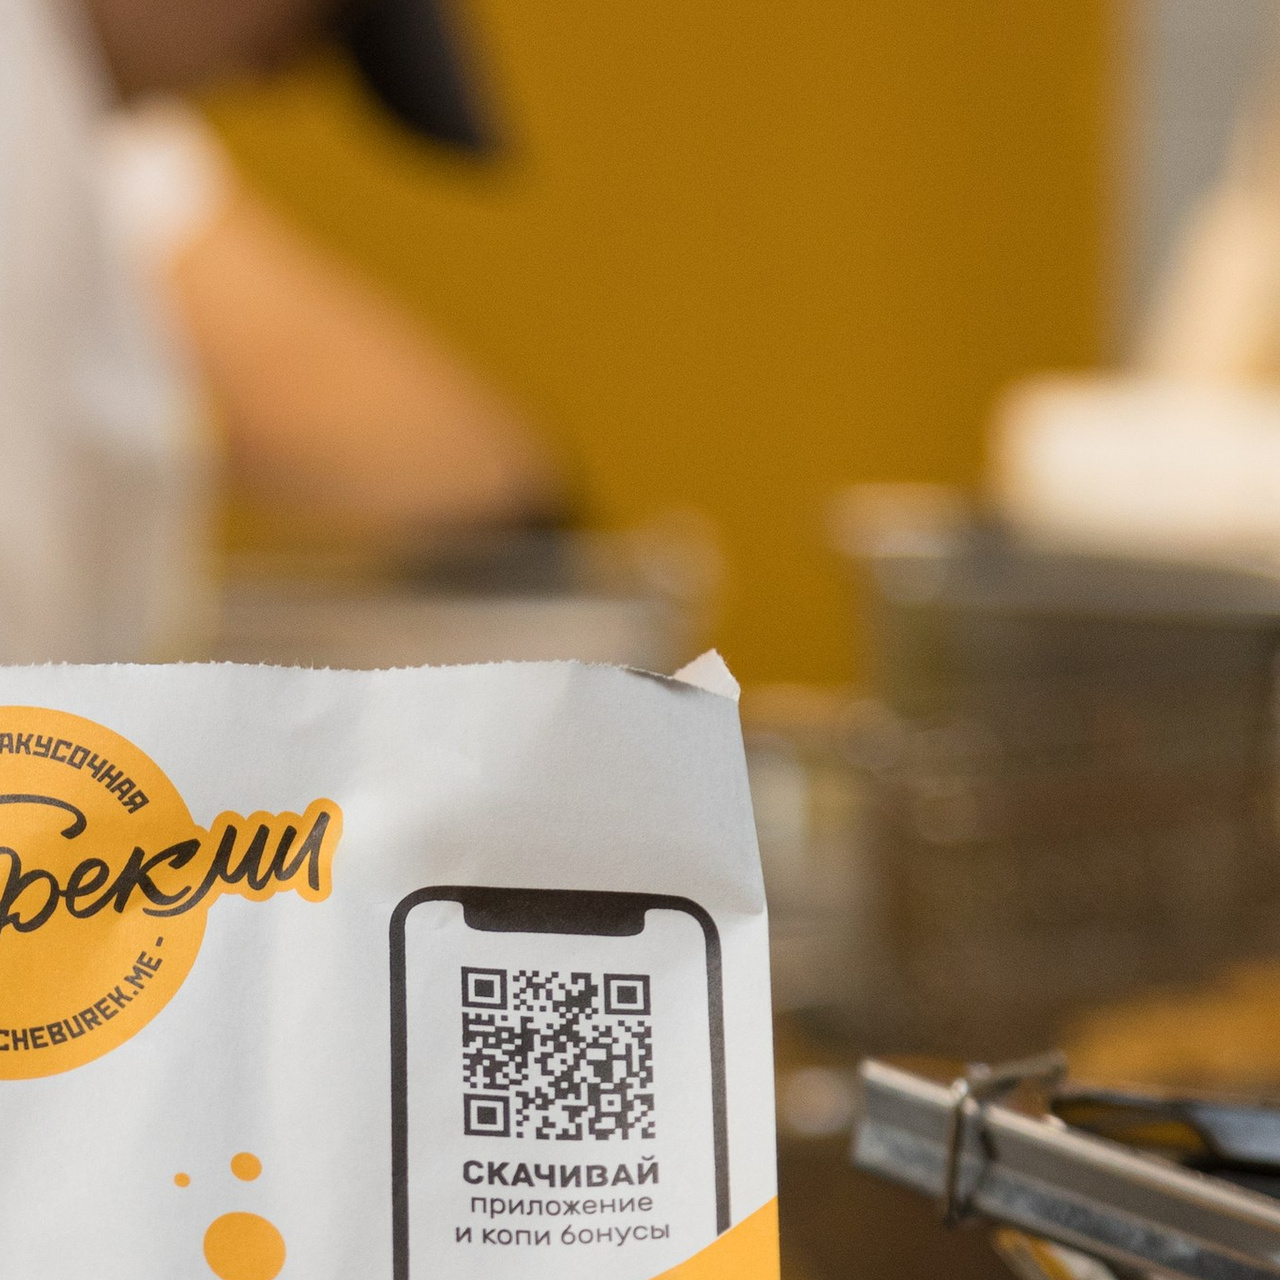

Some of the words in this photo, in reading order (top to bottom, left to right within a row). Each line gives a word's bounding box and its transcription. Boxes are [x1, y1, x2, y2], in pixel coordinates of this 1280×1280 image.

[462, 1155, 659, 1187] СКАЧИВАЙ
[471, 1195, 653, 1218] приложение
[456, 1226, 472, 1243] и
[482, 1227, 551, 1246] копи
[561, 1223, 670, 1246] бонусы
